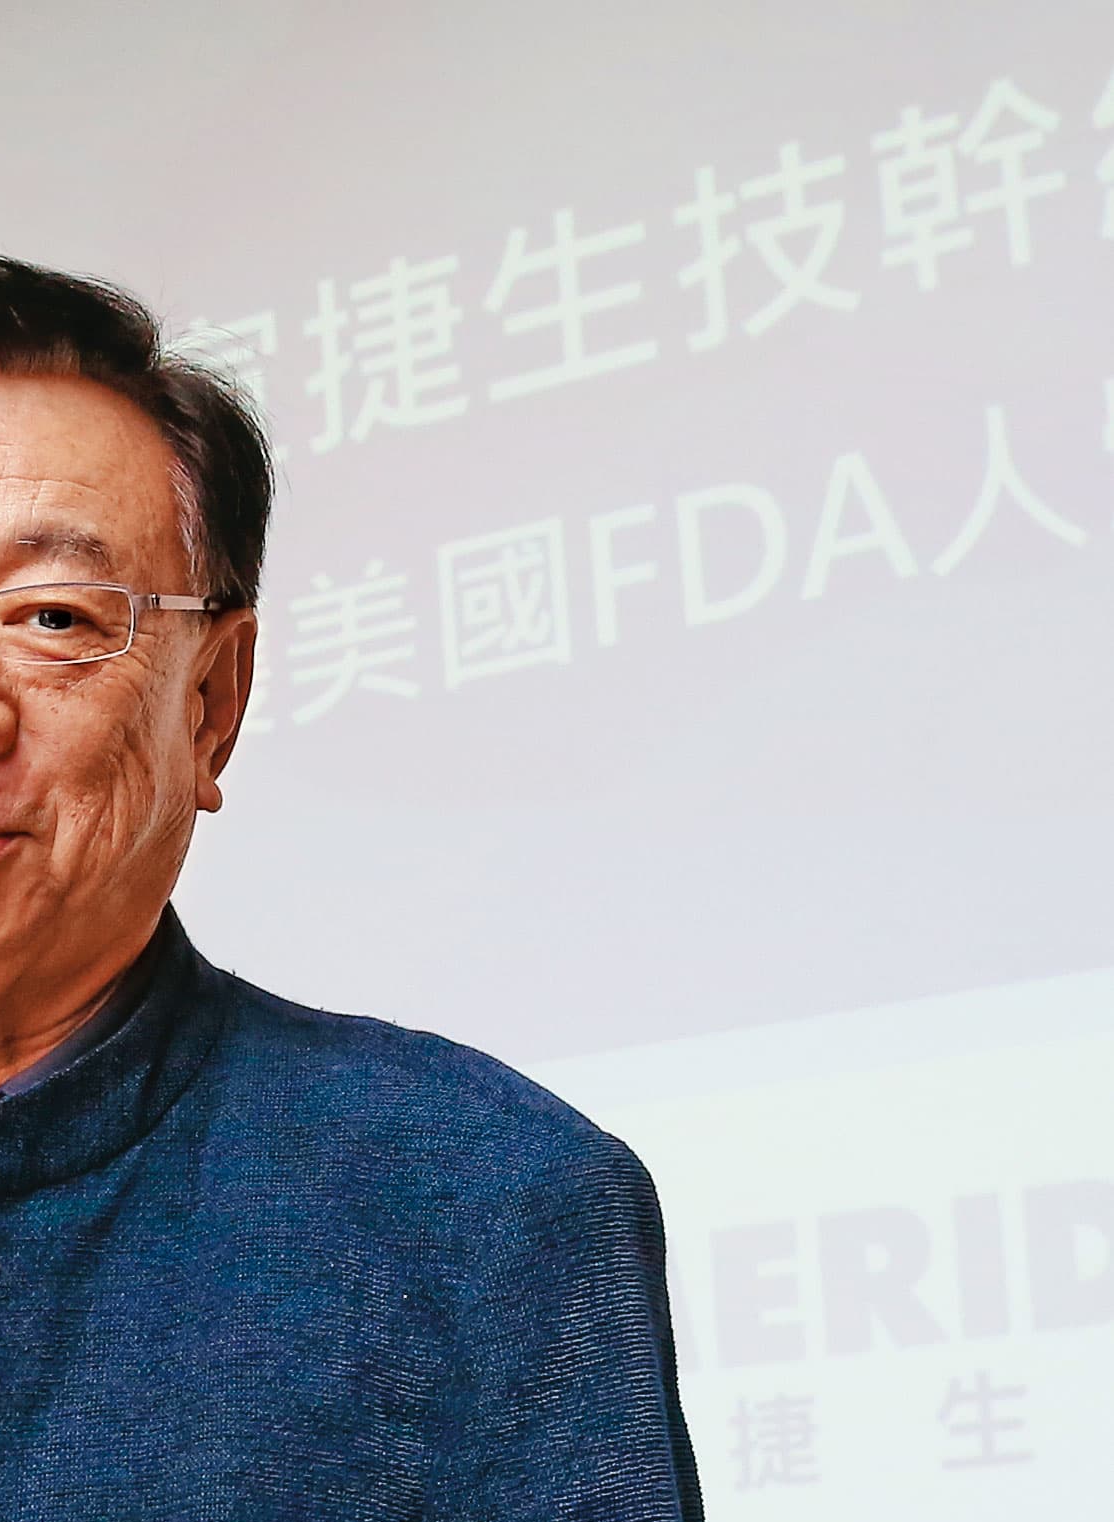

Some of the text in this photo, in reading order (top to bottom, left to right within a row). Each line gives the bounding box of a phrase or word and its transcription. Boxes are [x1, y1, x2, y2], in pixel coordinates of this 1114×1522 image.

[188, 62, 1114, 460] 捷生技幹
[244, 380, 1114, 735] 美國FDA人
[666, 1177, 1114, 1376] ERID
